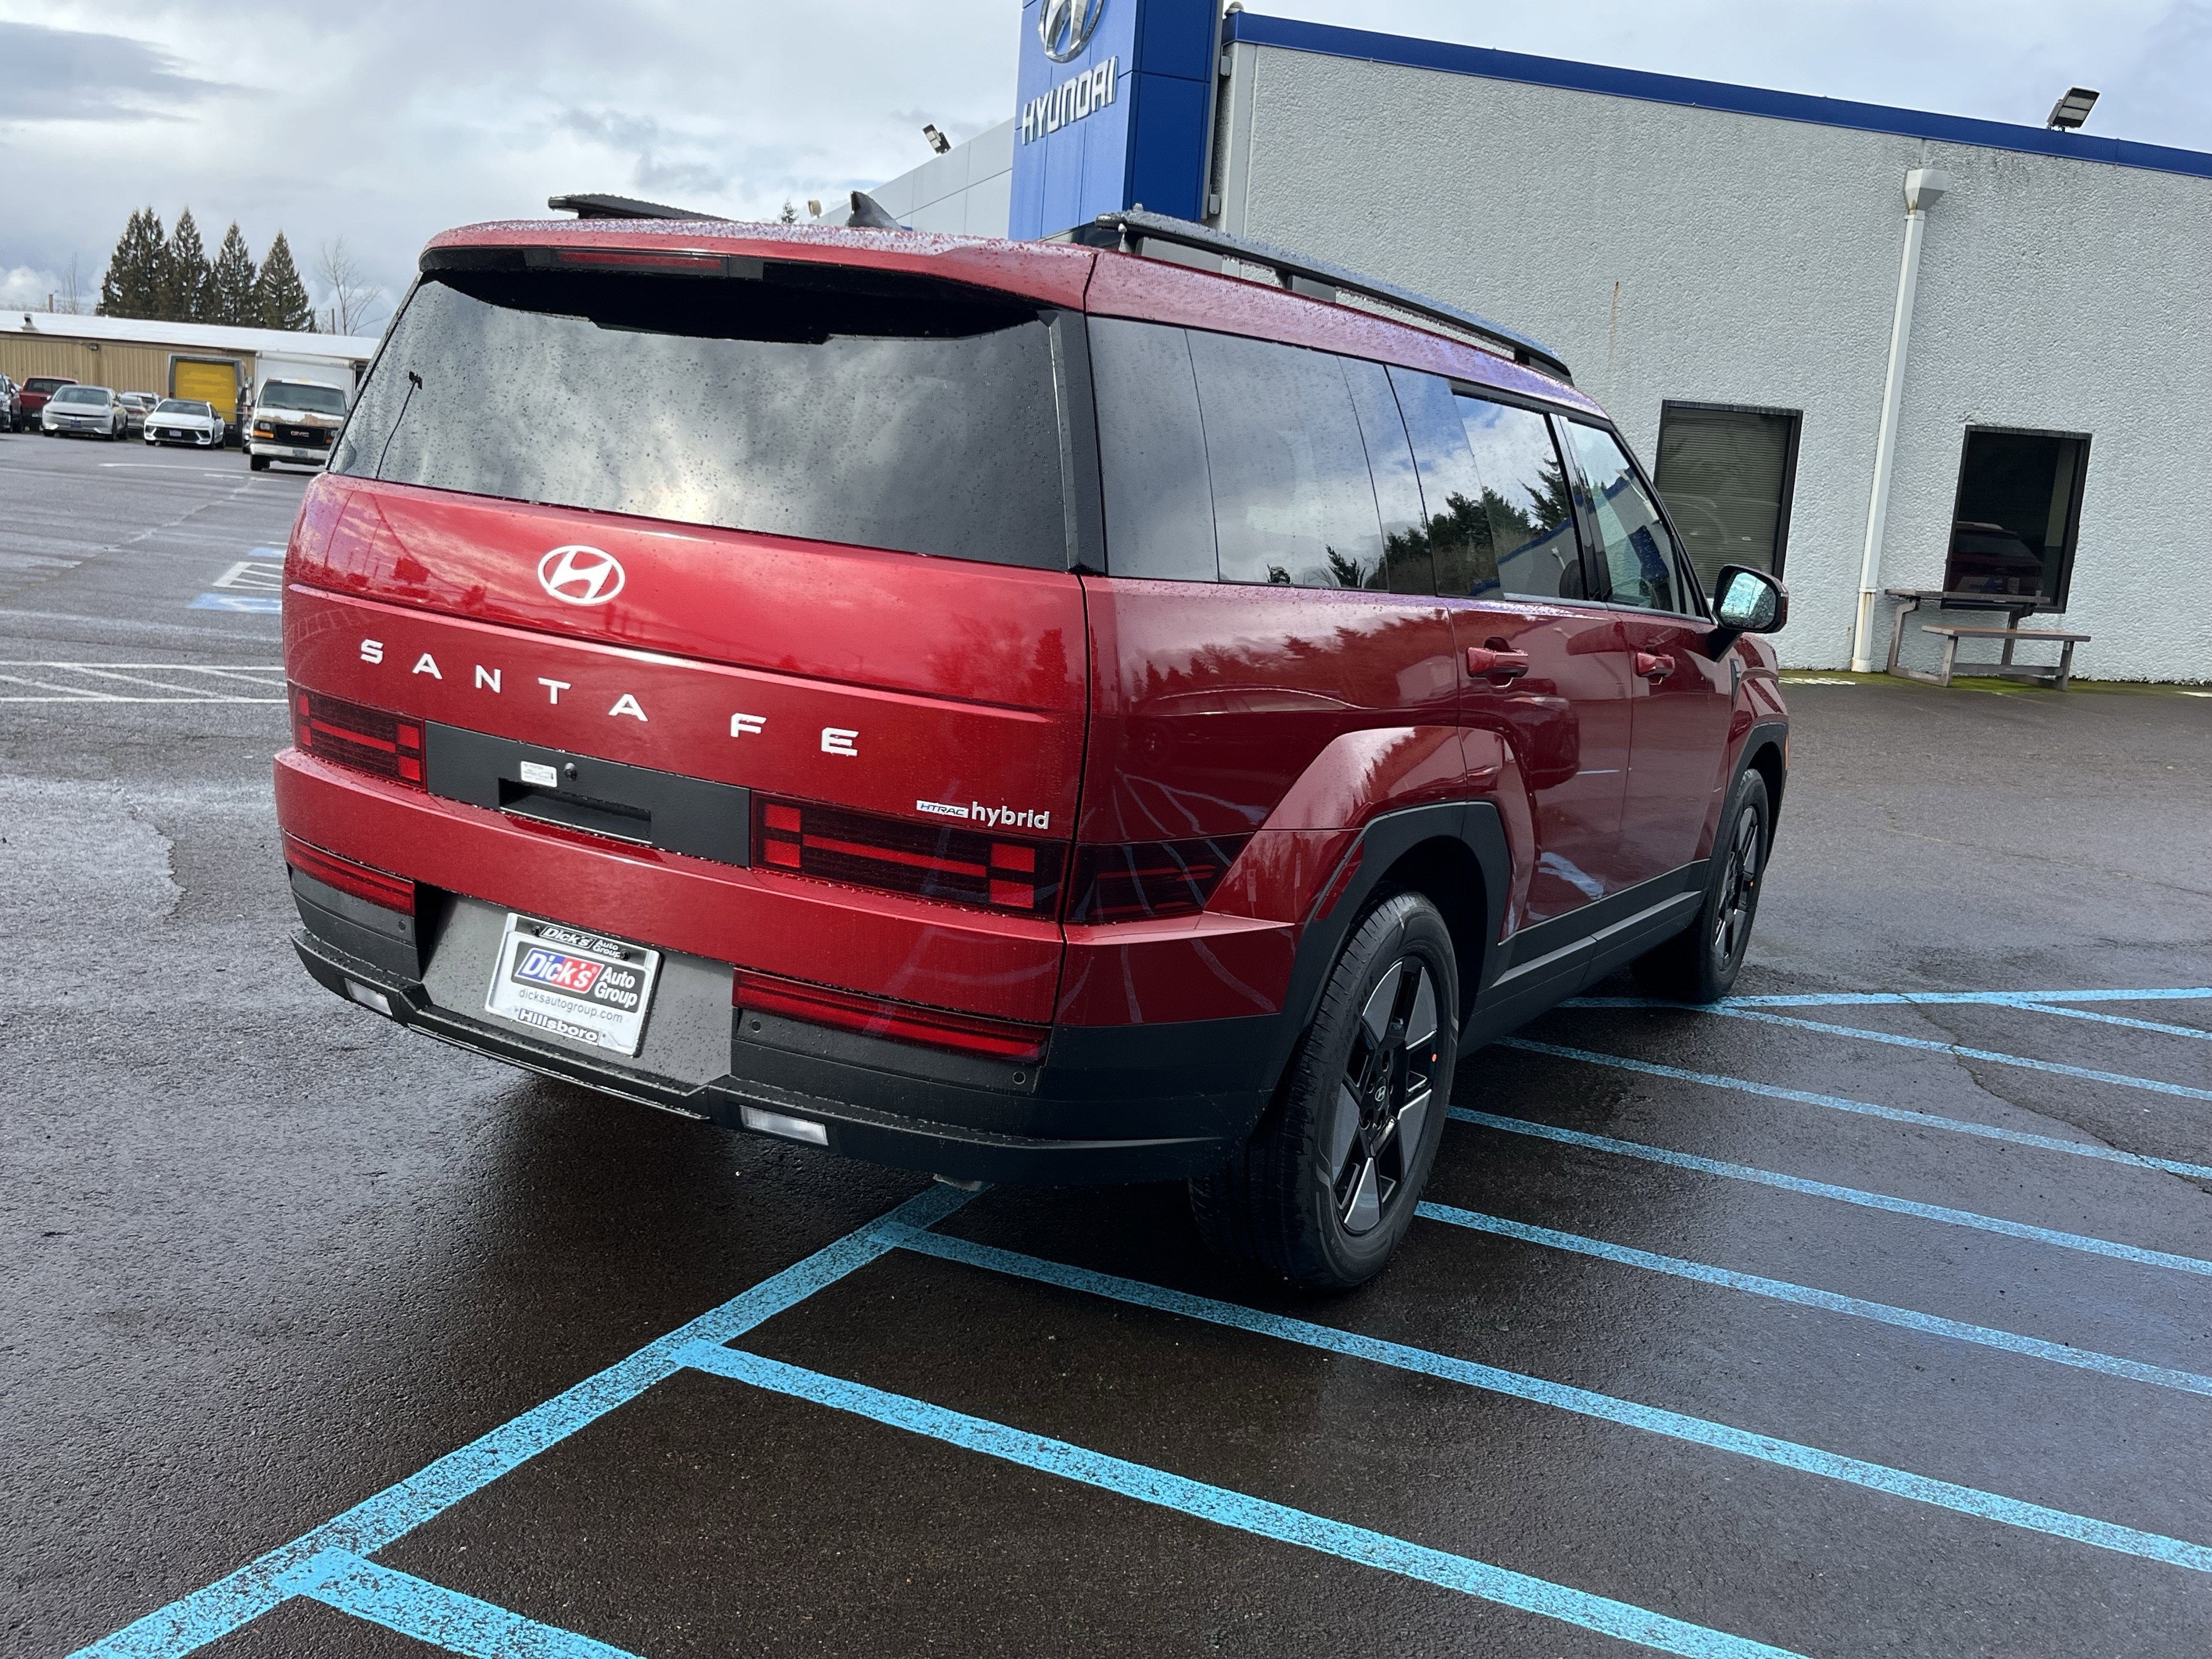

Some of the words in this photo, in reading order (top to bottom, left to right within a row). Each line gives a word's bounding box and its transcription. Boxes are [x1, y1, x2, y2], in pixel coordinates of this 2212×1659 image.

[1022, 55, 1119, 146] HYUNDAI
[360, 639, 649, 723] SANTA
[730, 712, 860, 757] FE
[919, 802, 966, 816] HTRAC
[971, 800, 1050, 830] hybrid
[543, 927, 591, 947] Dick's
[596, 940, 619, 951] Auto
[521, 951, 594, 989] Dick's
[600, 966, 636, 989] Auto
[518, 989, 623, 1023] dicksautogroup.com
[594, 981, 638, 1009] Group
[518, 1008, 599, 1041] Hillsboro
